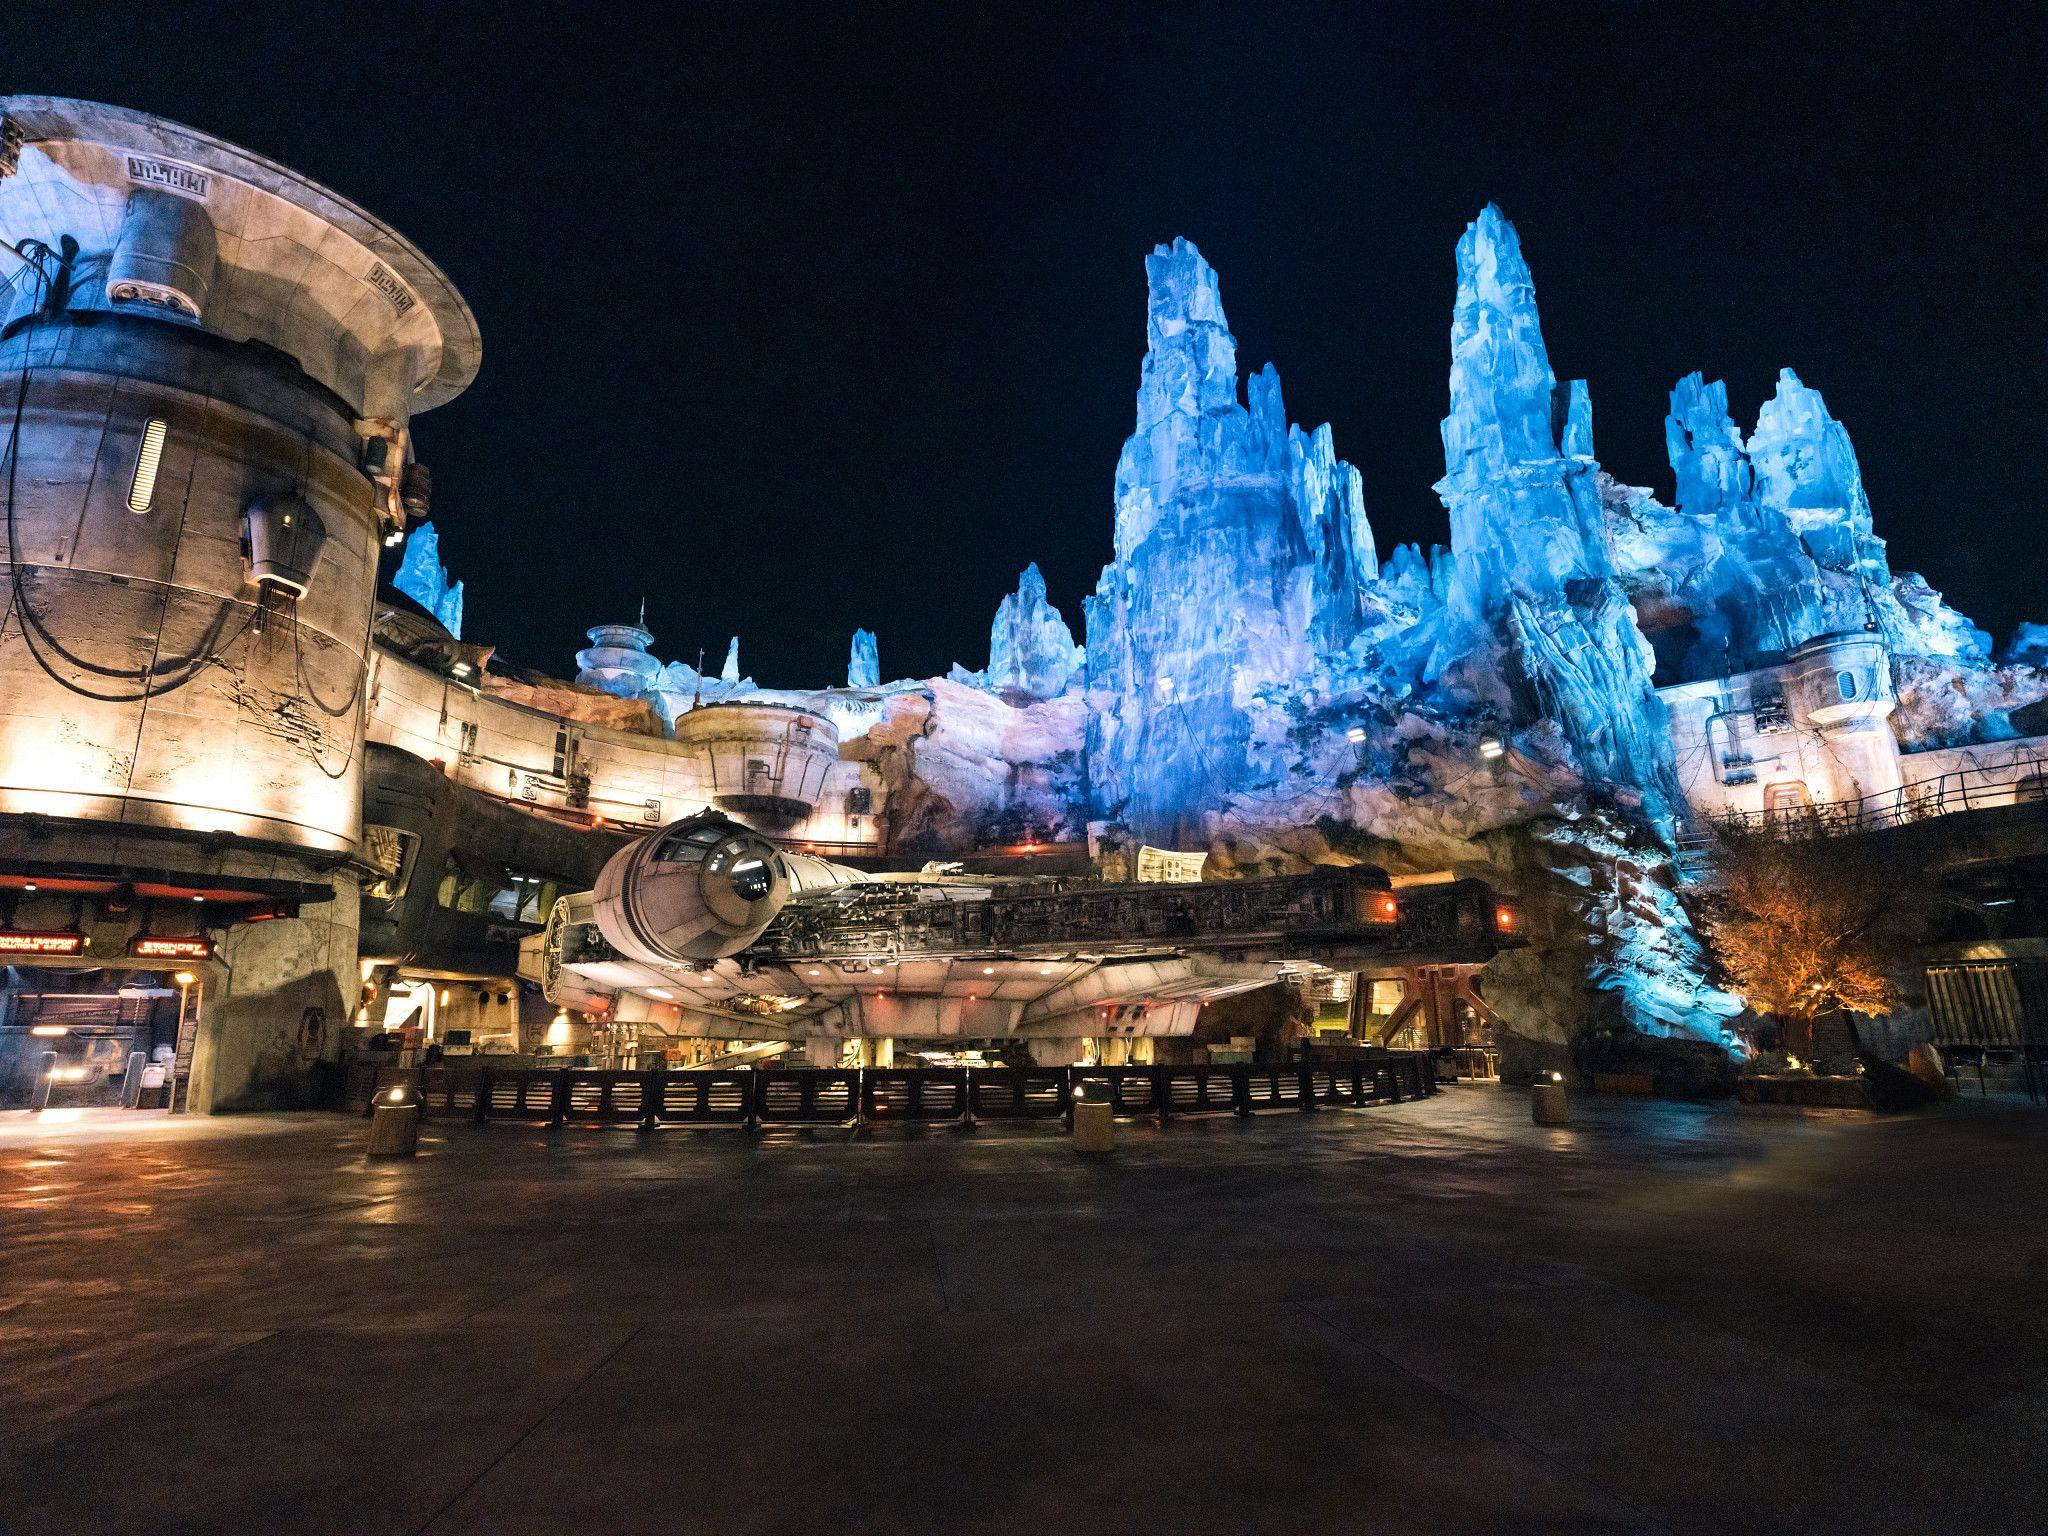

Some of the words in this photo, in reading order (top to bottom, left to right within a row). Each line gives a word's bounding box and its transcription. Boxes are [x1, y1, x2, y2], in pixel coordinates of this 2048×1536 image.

[0, 942, 39, 950] OLUTIONS
[33, 937, 78, 946] TRANSPORT
[144, 941, 202, 951] STANDBY
